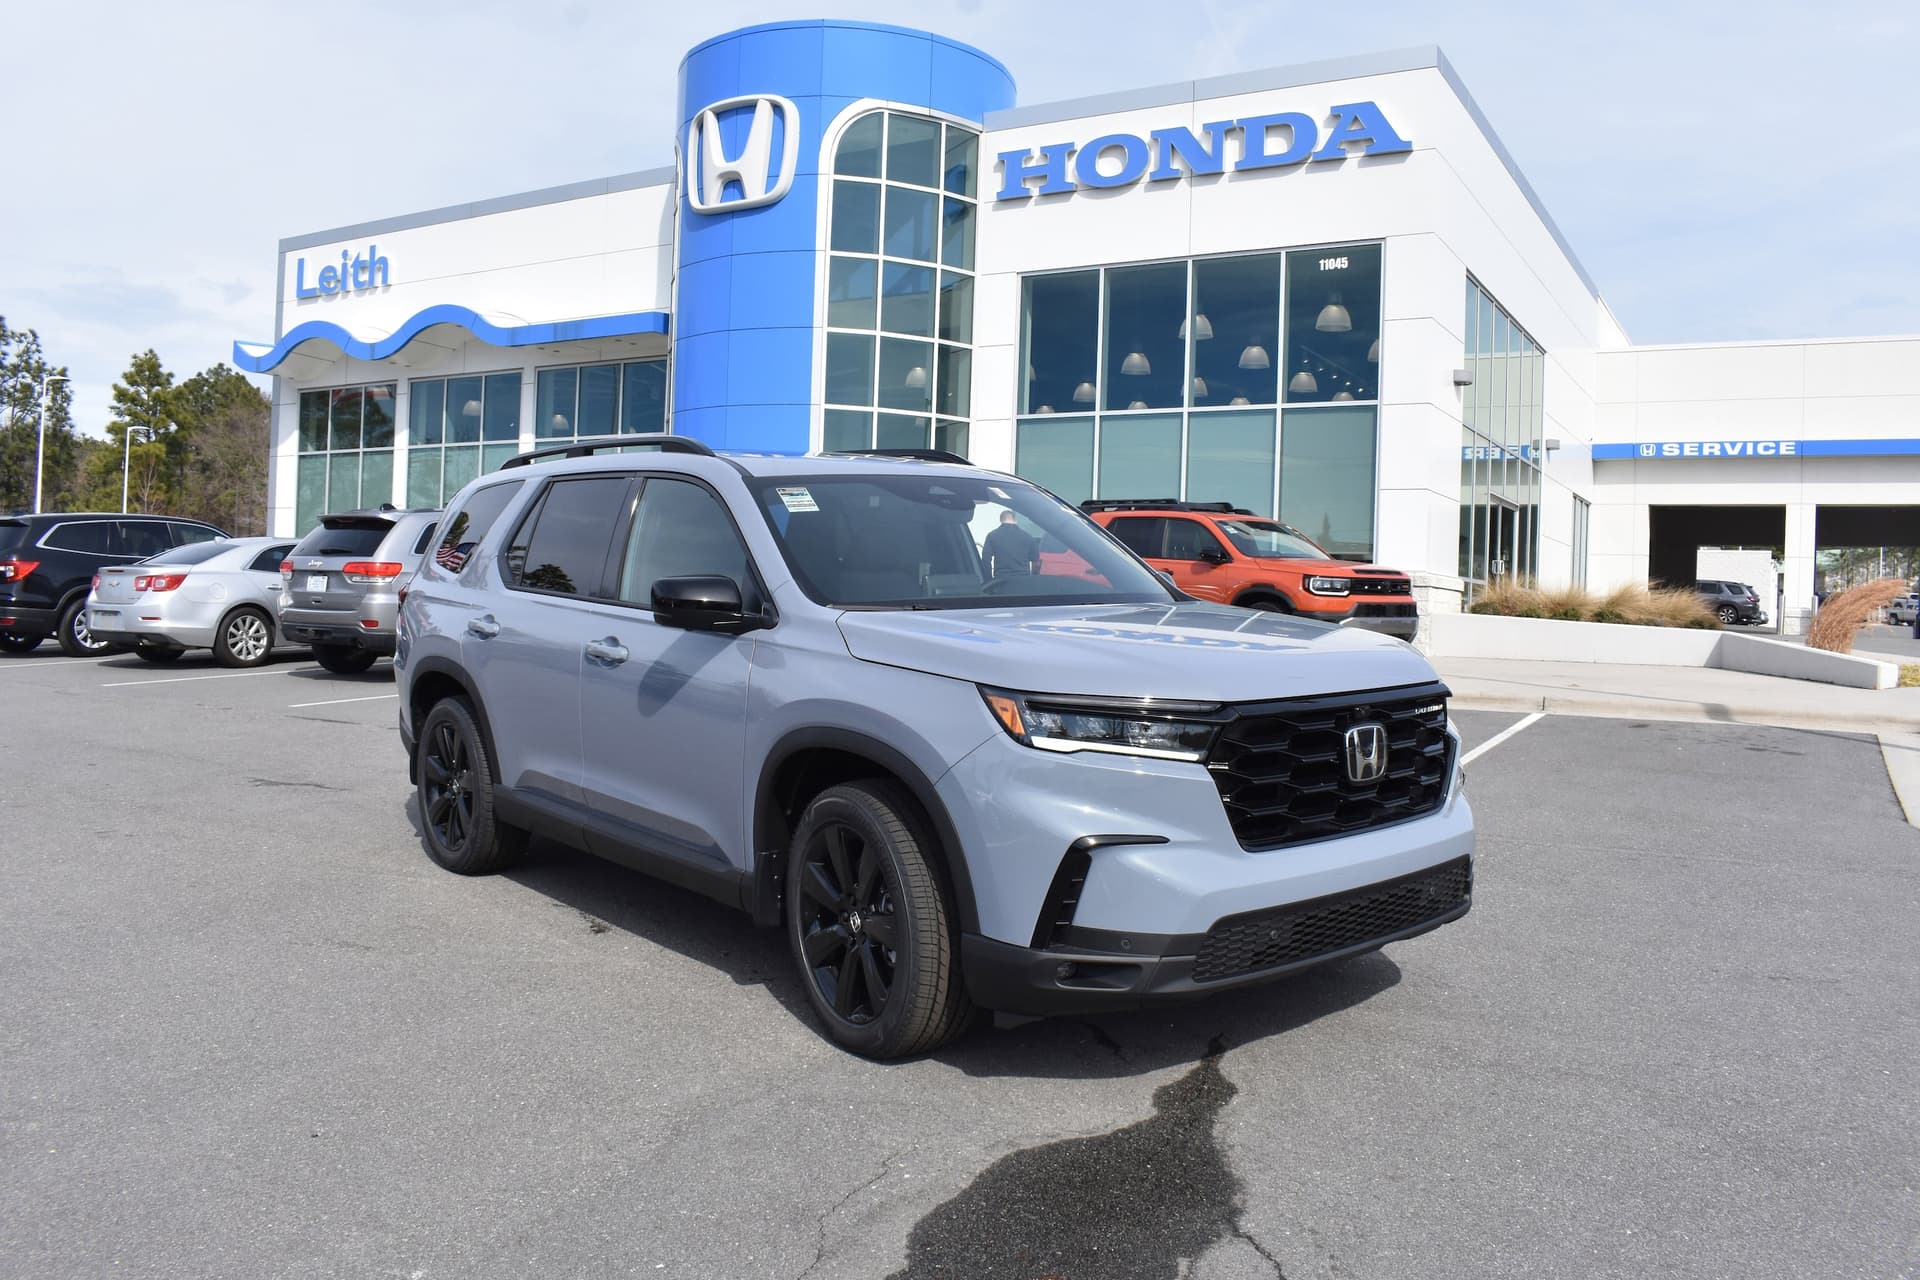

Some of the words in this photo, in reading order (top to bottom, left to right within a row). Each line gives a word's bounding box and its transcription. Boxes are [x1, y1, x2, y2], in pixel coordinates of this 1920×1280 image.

[996, 101, 1412, 201] HONDA
[296, 245, 388, 299] Leith
[1319, 256, 1348, 271] 11045
[1662, 441, 1796, 456] SERVICE
